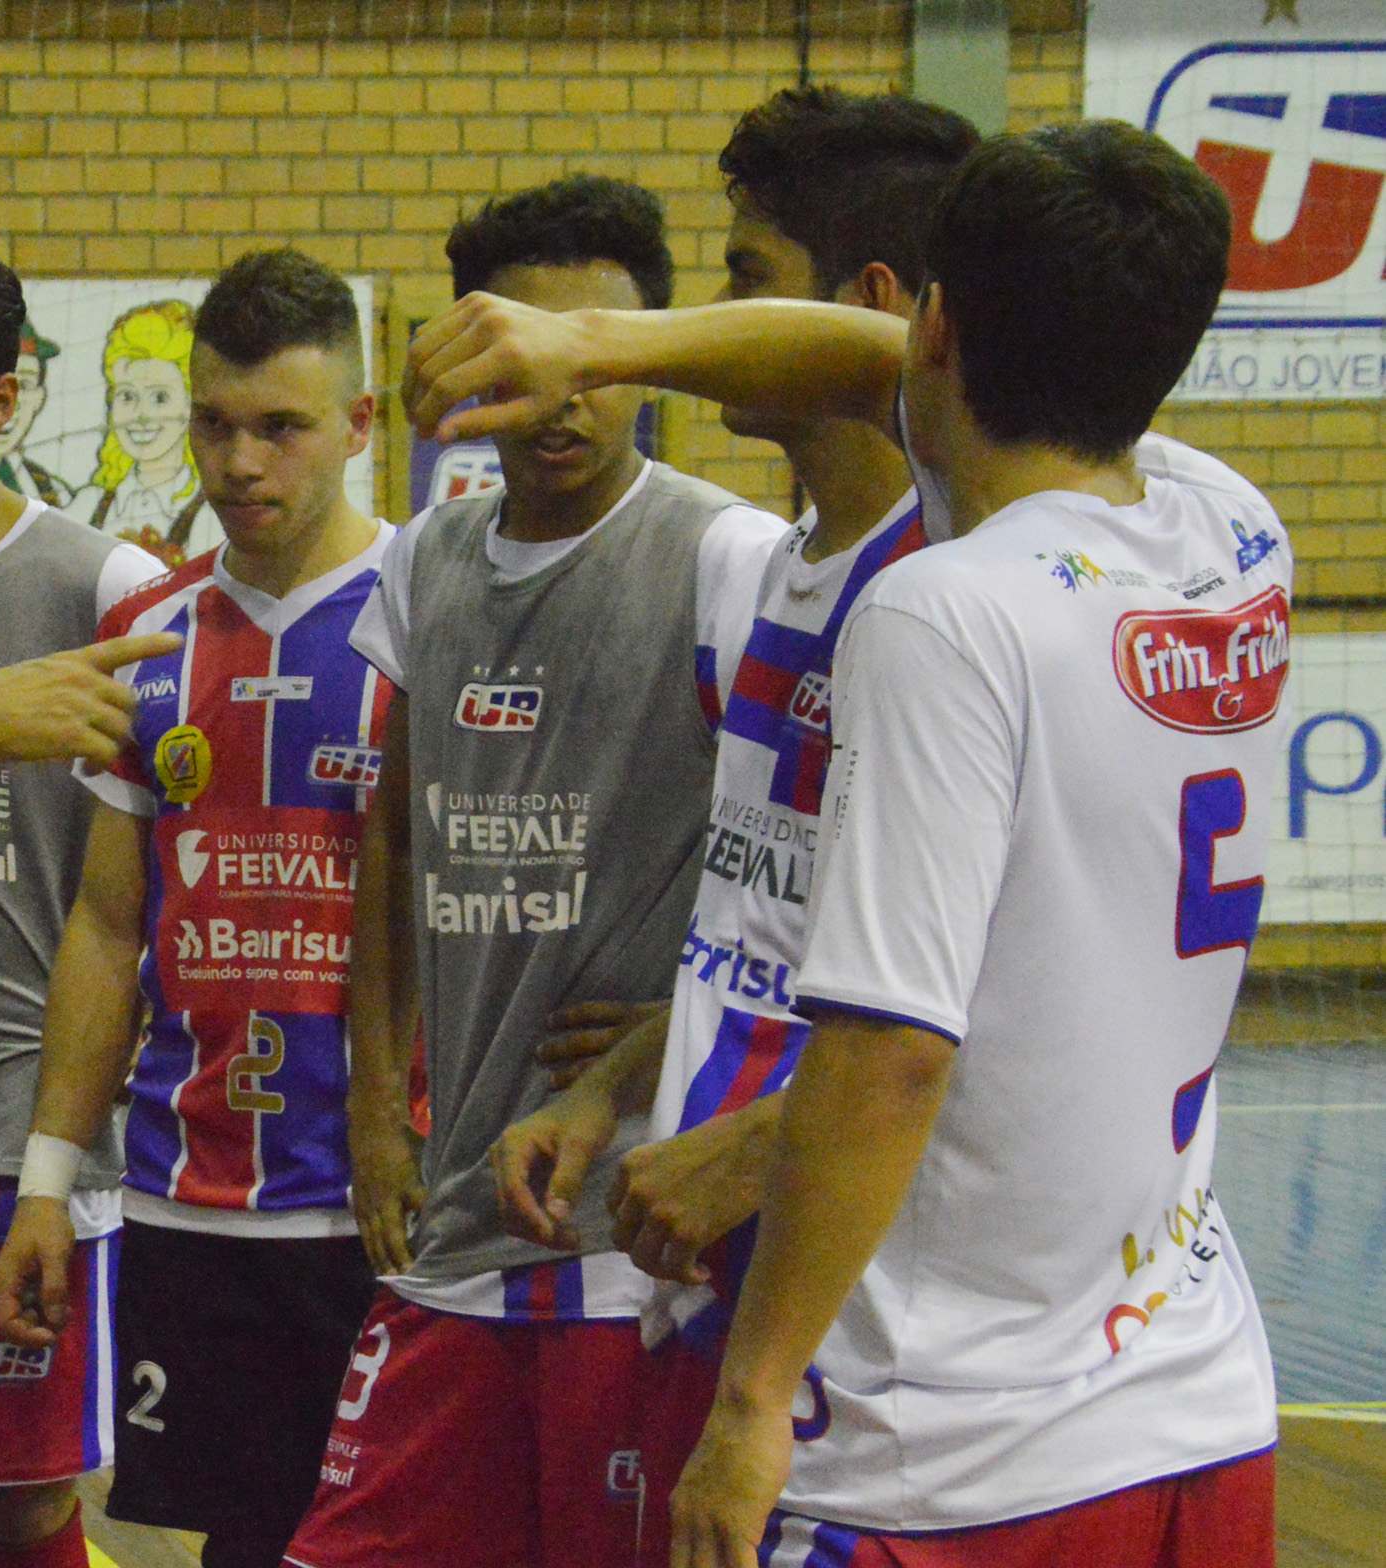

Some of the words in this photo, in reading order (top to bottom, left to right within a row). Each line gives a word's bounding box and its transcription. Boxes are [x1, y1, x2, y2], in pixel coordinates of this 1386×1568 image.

[1183, 576, 1227, 600] ESPORTE
[1134, 632, 1218, 698] Fritz
[217, 833, 358, 853] UNIVERSIDAD
[283, 969, 314, 982] com
[227, 1015, 285, 1114] 2
[126, 1359, 168, 1433] 2
[336, 1322, 391, 1421] 3
